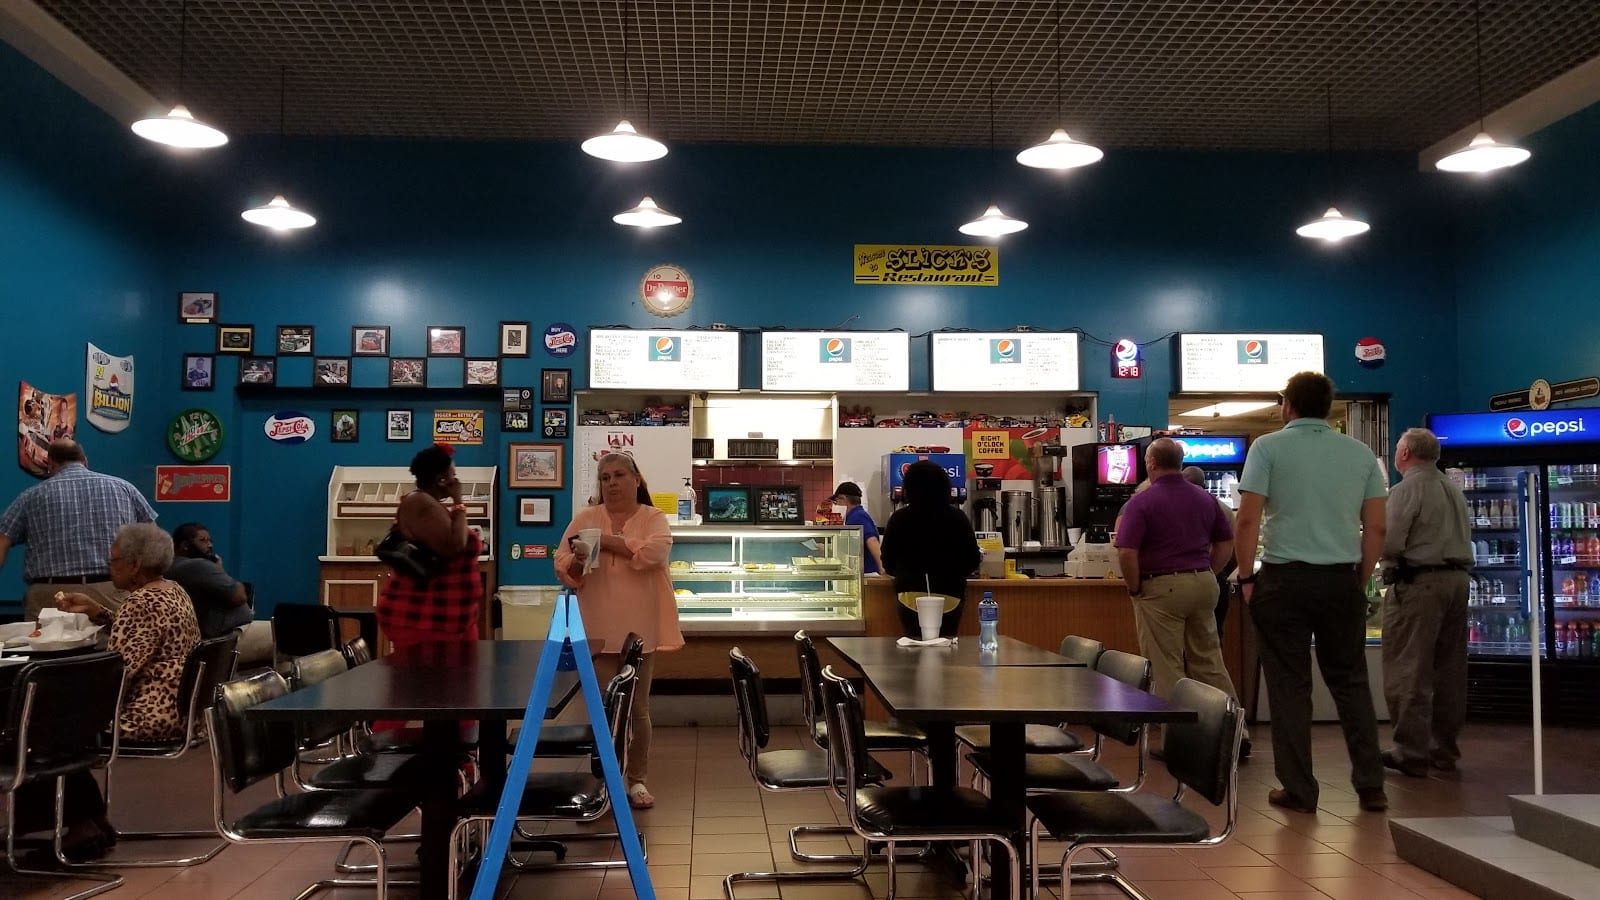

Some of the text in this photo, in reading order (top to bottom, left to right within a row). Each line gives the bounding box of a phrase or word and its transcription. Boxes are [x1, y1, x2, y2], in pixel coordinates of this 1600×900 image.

[882, 272, 984, 283] Restaurant
[646, 283, 658, 292] Dr
[94, 389, 131, 412] BILLION
[1530, 418, 1583, 437] pepsi
